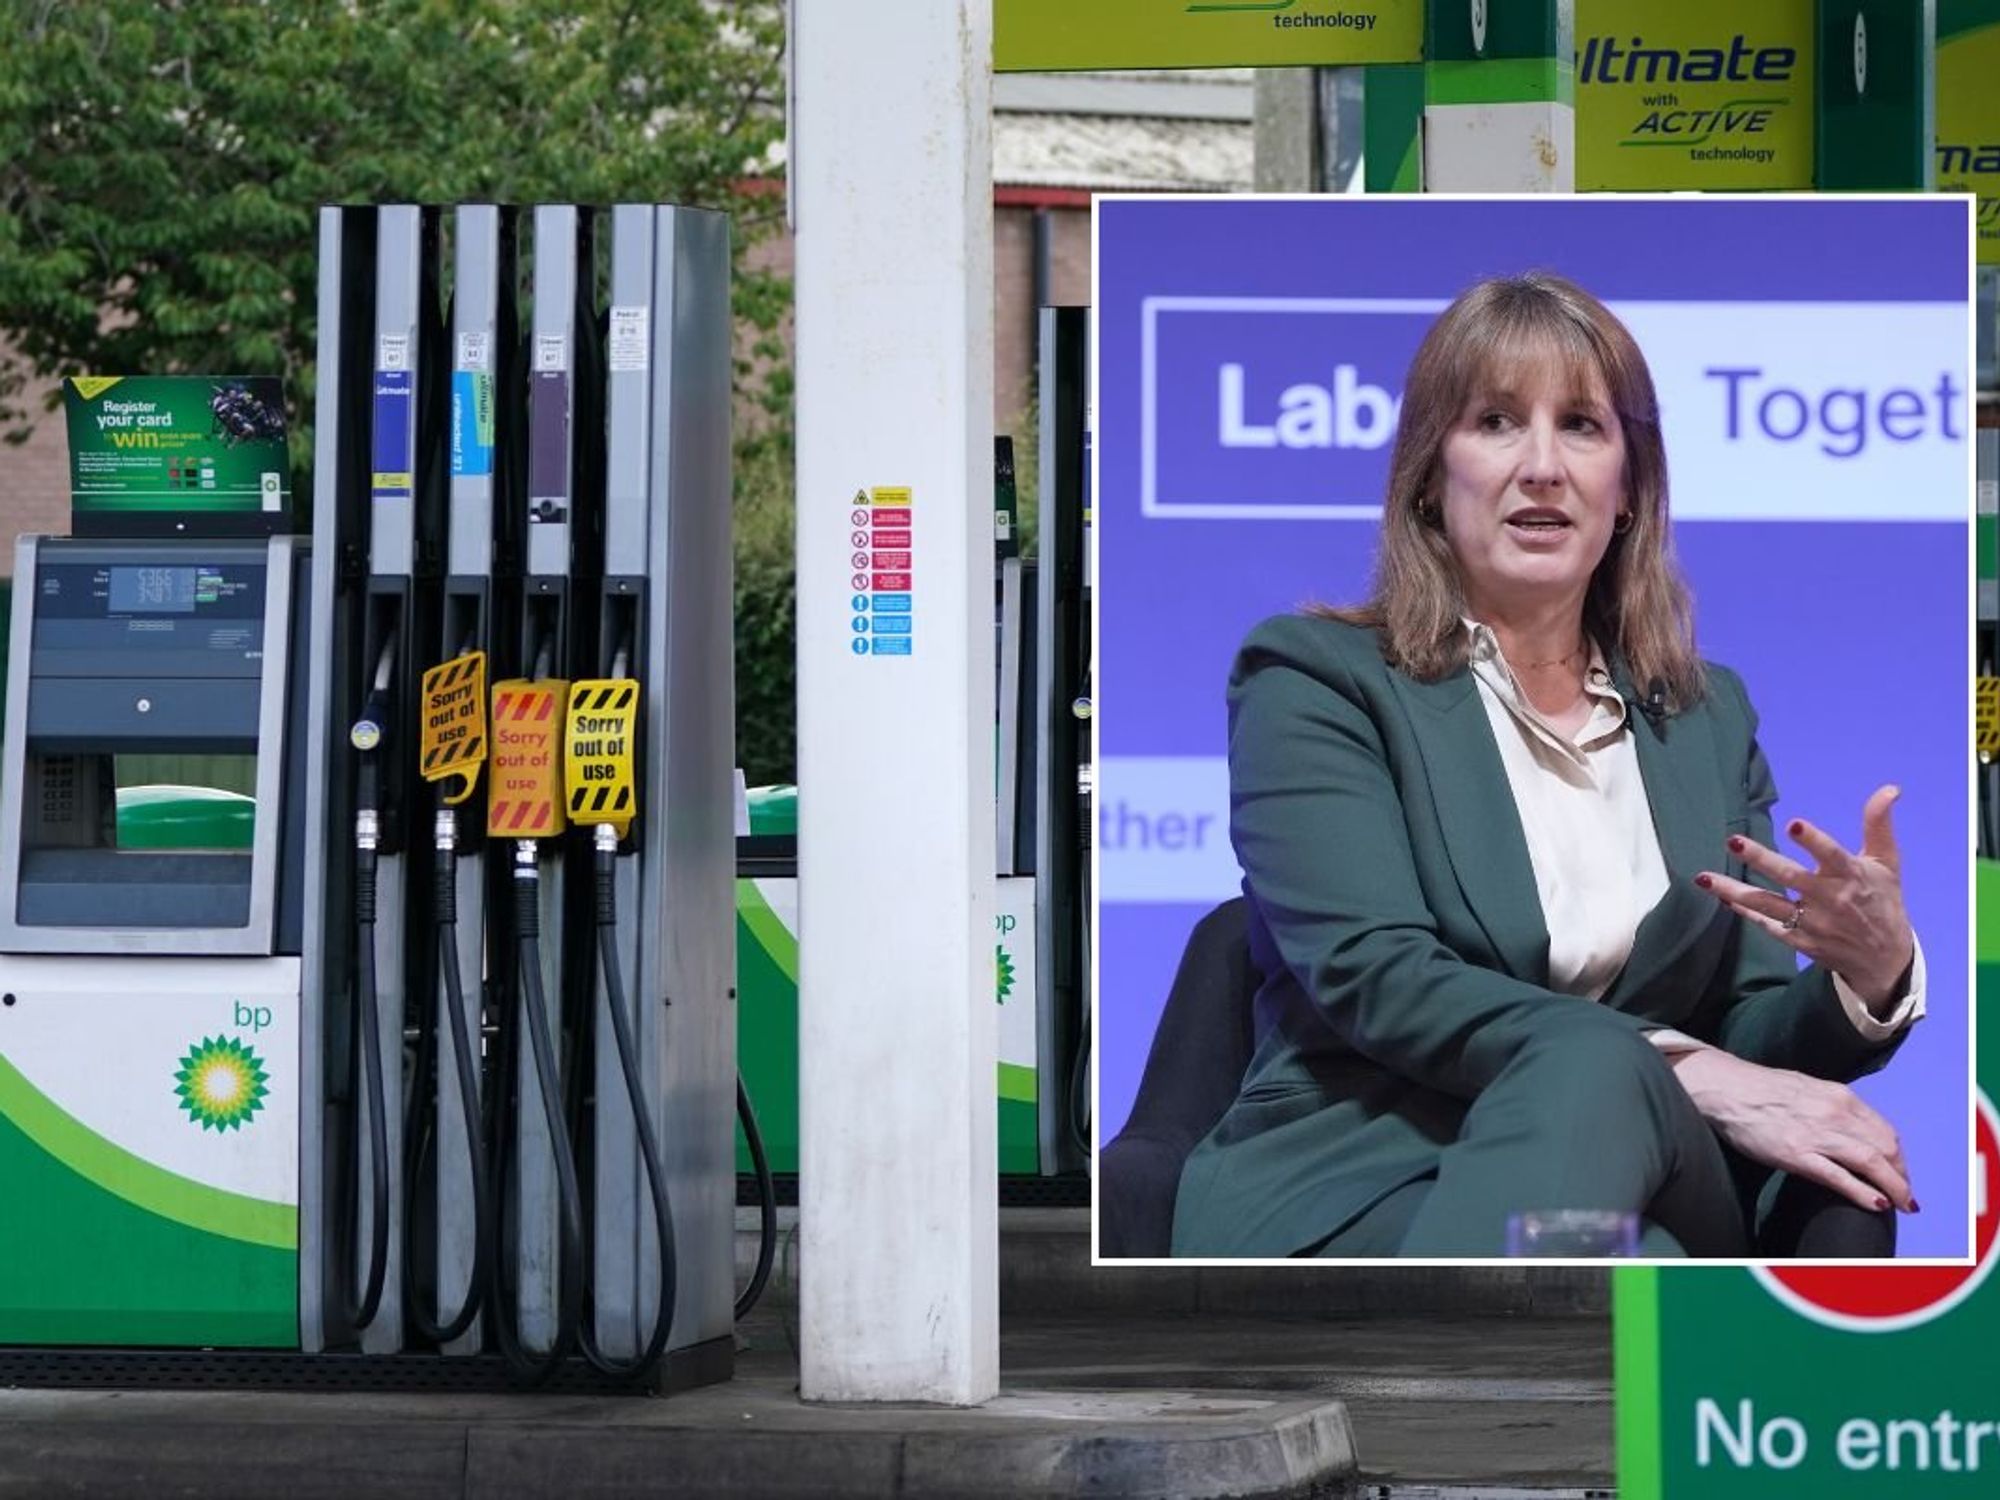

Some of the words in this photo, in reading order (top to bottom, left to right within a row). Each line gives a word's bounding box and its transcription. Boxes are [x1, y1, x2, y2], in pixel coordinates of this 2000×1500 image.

[1273, 12, 1377, 31] technology
[1575, 35, 1796, 83] ltimate
[1643, 93, 1679, 107] with
[1632, 110, 1773, 133] ACTIVE
[1690, 148, 1775, 162] technology
[103, 400, 157, 415] Register
[1219, 363, 1403, 449] Lab
[1704, 369, 1962, 458] Toget
[96, 415, 134, 431] your
[137, 412, 172, 427] card
[113, 427, 159, 448] win
[431, 683, 472, 709] Sorry
[430, 707, 455, 728] out
[460, 699, 475, 717] of
[438, 725, 467, 743] use
[576, 716, 625, 734] Sorry
[498, 729, 547, 748] Sorry
[573, 739, 603, 757] out
[607, 737, 625, 756] of
[496, 755, 525, 767] out
[530, 751, 549, 767] of
[583, 764, 616, 780] use
[506, 779, 537, 790] use
[234, 1000, 272, 1033] bp
[1695, 1398, 1808, 1469] No
[1836, 1409, 2000, 1471] entr
